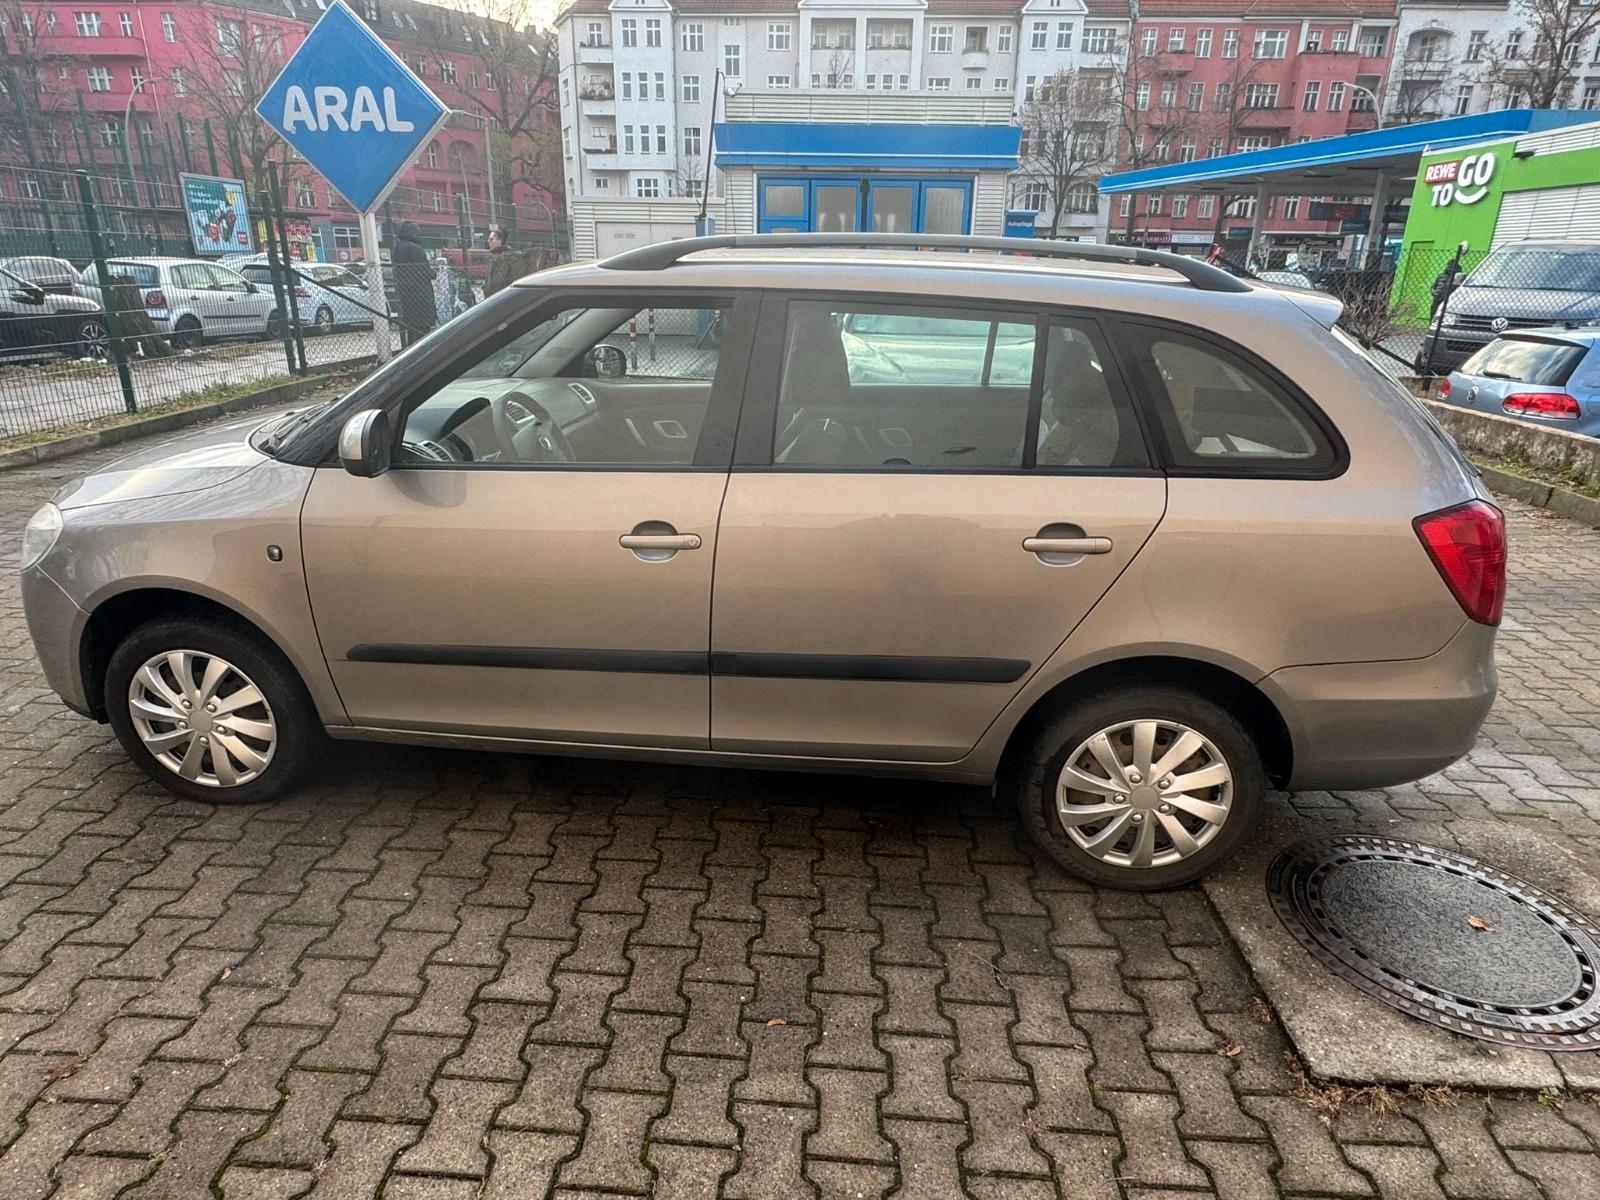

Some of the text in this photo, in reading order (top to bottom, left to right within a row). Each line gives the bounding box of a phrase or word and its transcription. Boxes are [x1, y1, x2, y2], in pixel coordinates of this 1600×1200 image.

[283, 85, 415, 132] ARAL
[1426, 163, 1457, 181] REWE
[1431, 152, 1495, 207] TO GO
